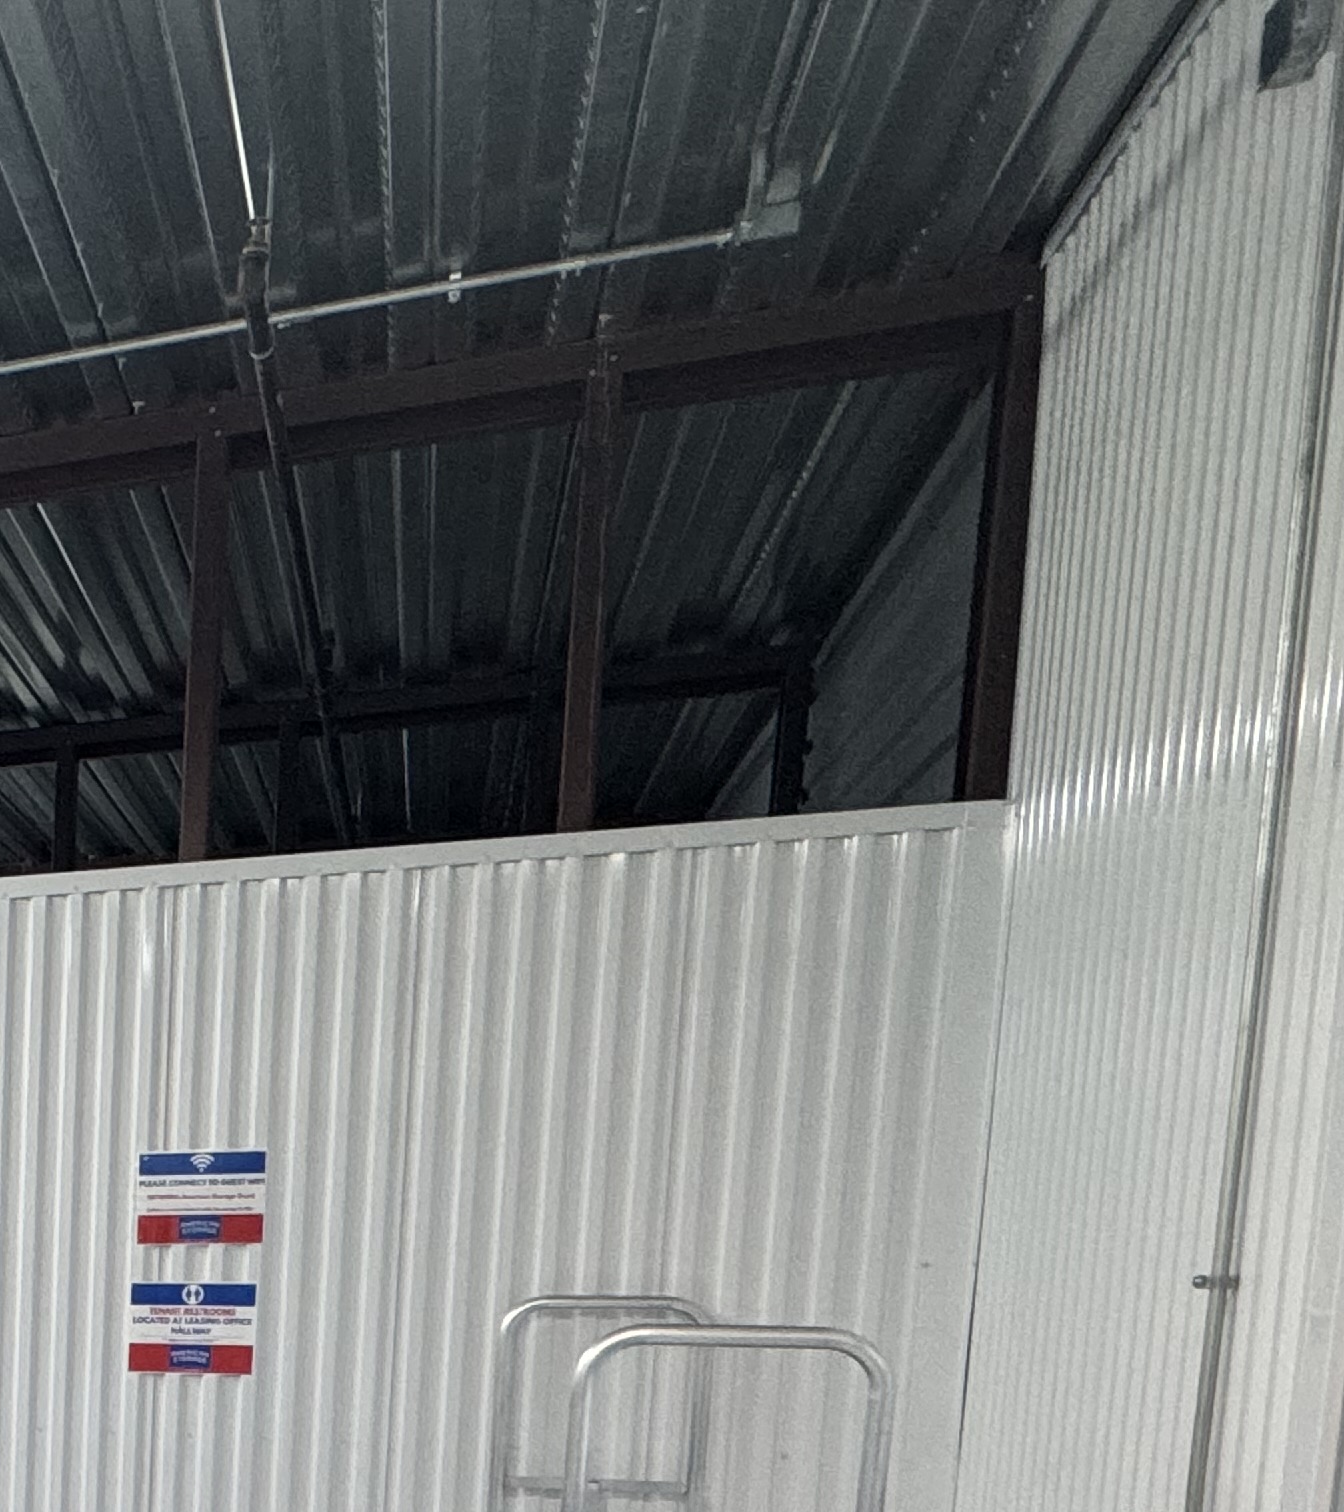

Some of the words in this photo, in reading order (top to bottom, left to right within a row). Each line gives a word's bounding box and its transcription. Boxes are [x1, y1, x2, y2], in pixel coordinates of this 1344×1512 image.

[132, 1316, 170, 1324] LOCATED
[172, 1317, 183, 1325] AT
[185, 1317, 221, 1325] LEASING
